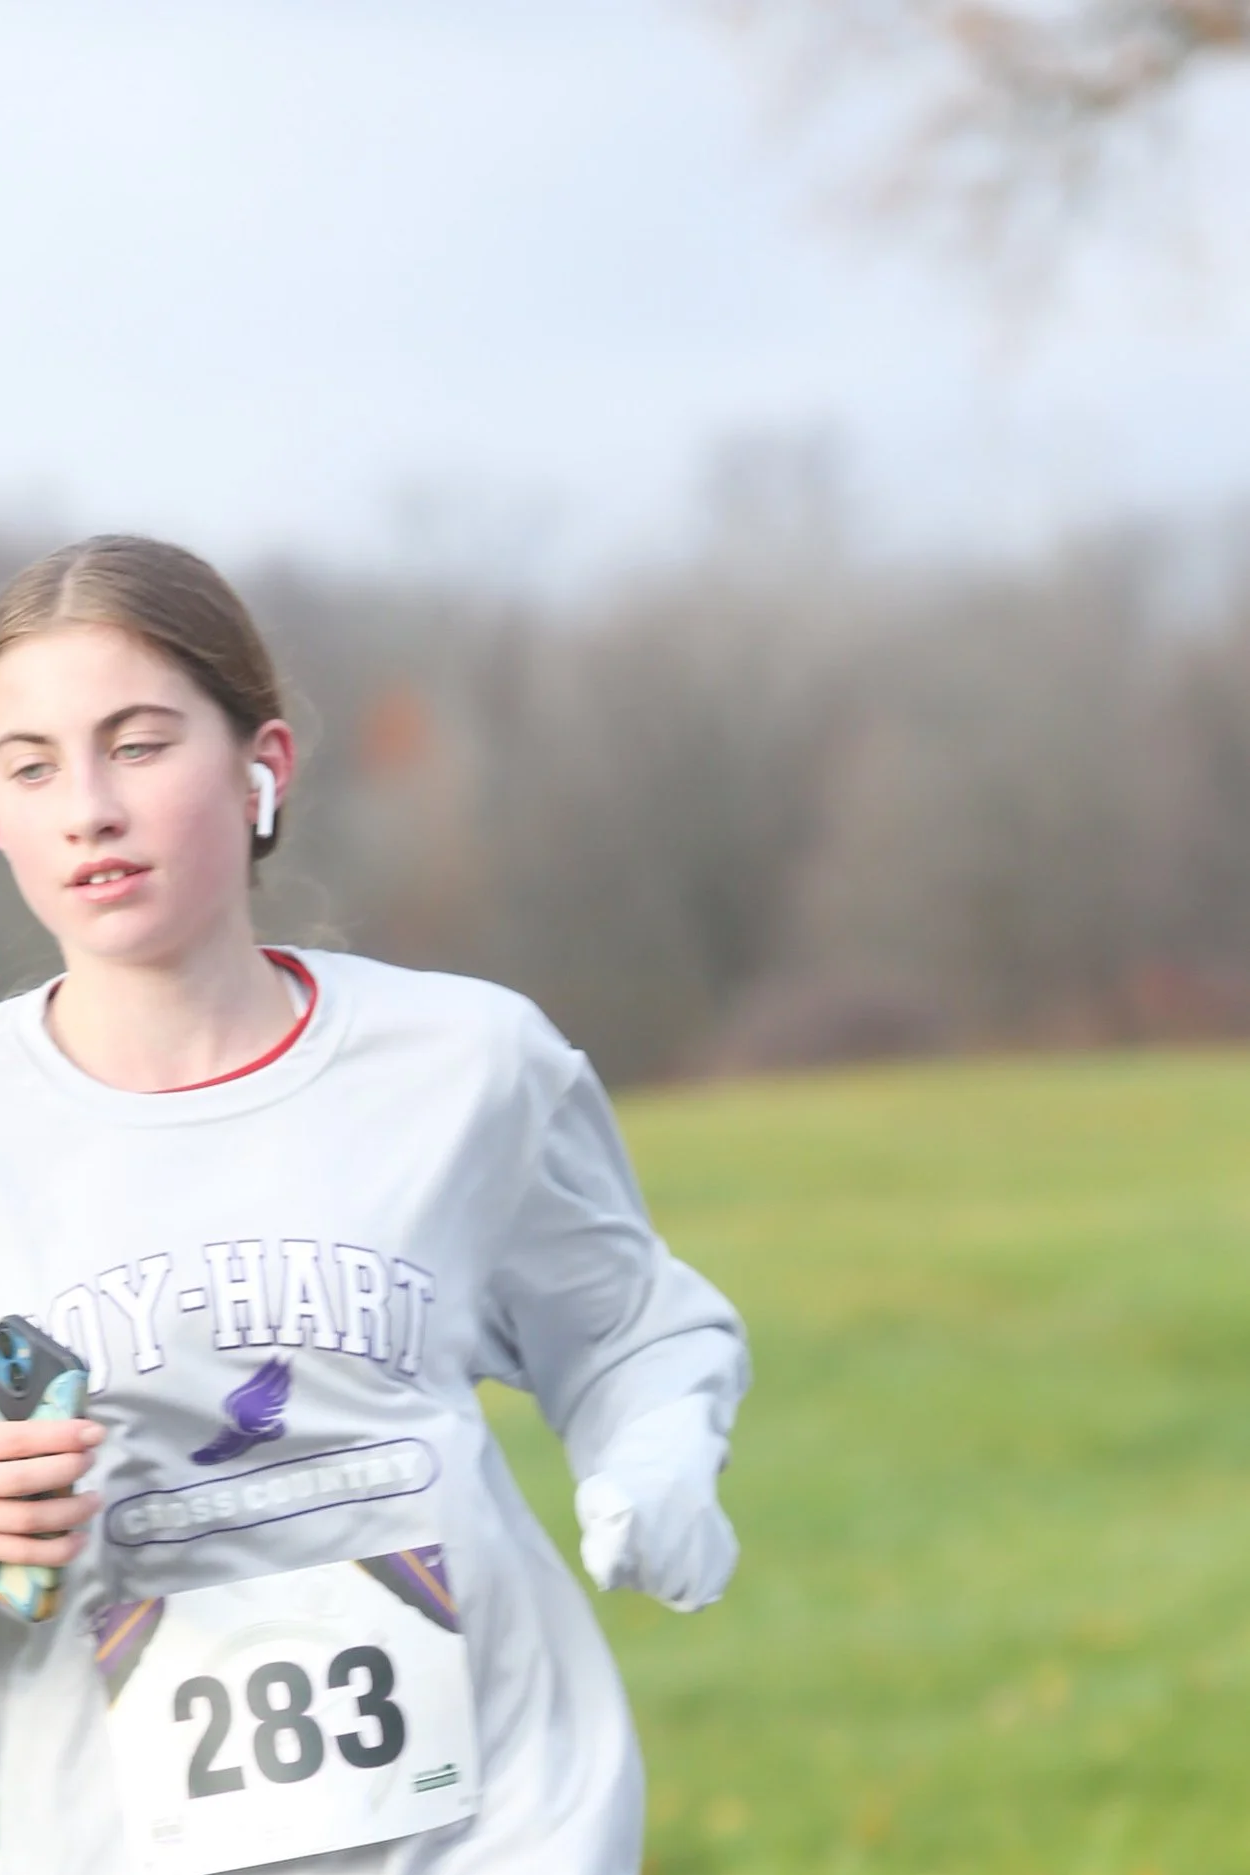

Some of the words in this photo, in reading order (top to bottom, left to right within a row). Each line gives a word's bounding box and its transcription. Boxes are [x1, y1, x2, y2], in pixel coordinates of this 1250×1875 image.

[24, 1238, 437, 1396] OY-HART
[121, 1488, 238, 1535] CROSS
[241, 1451, 419, 1511] COUNTRY
[172, 1644, 406, 1800] 283
